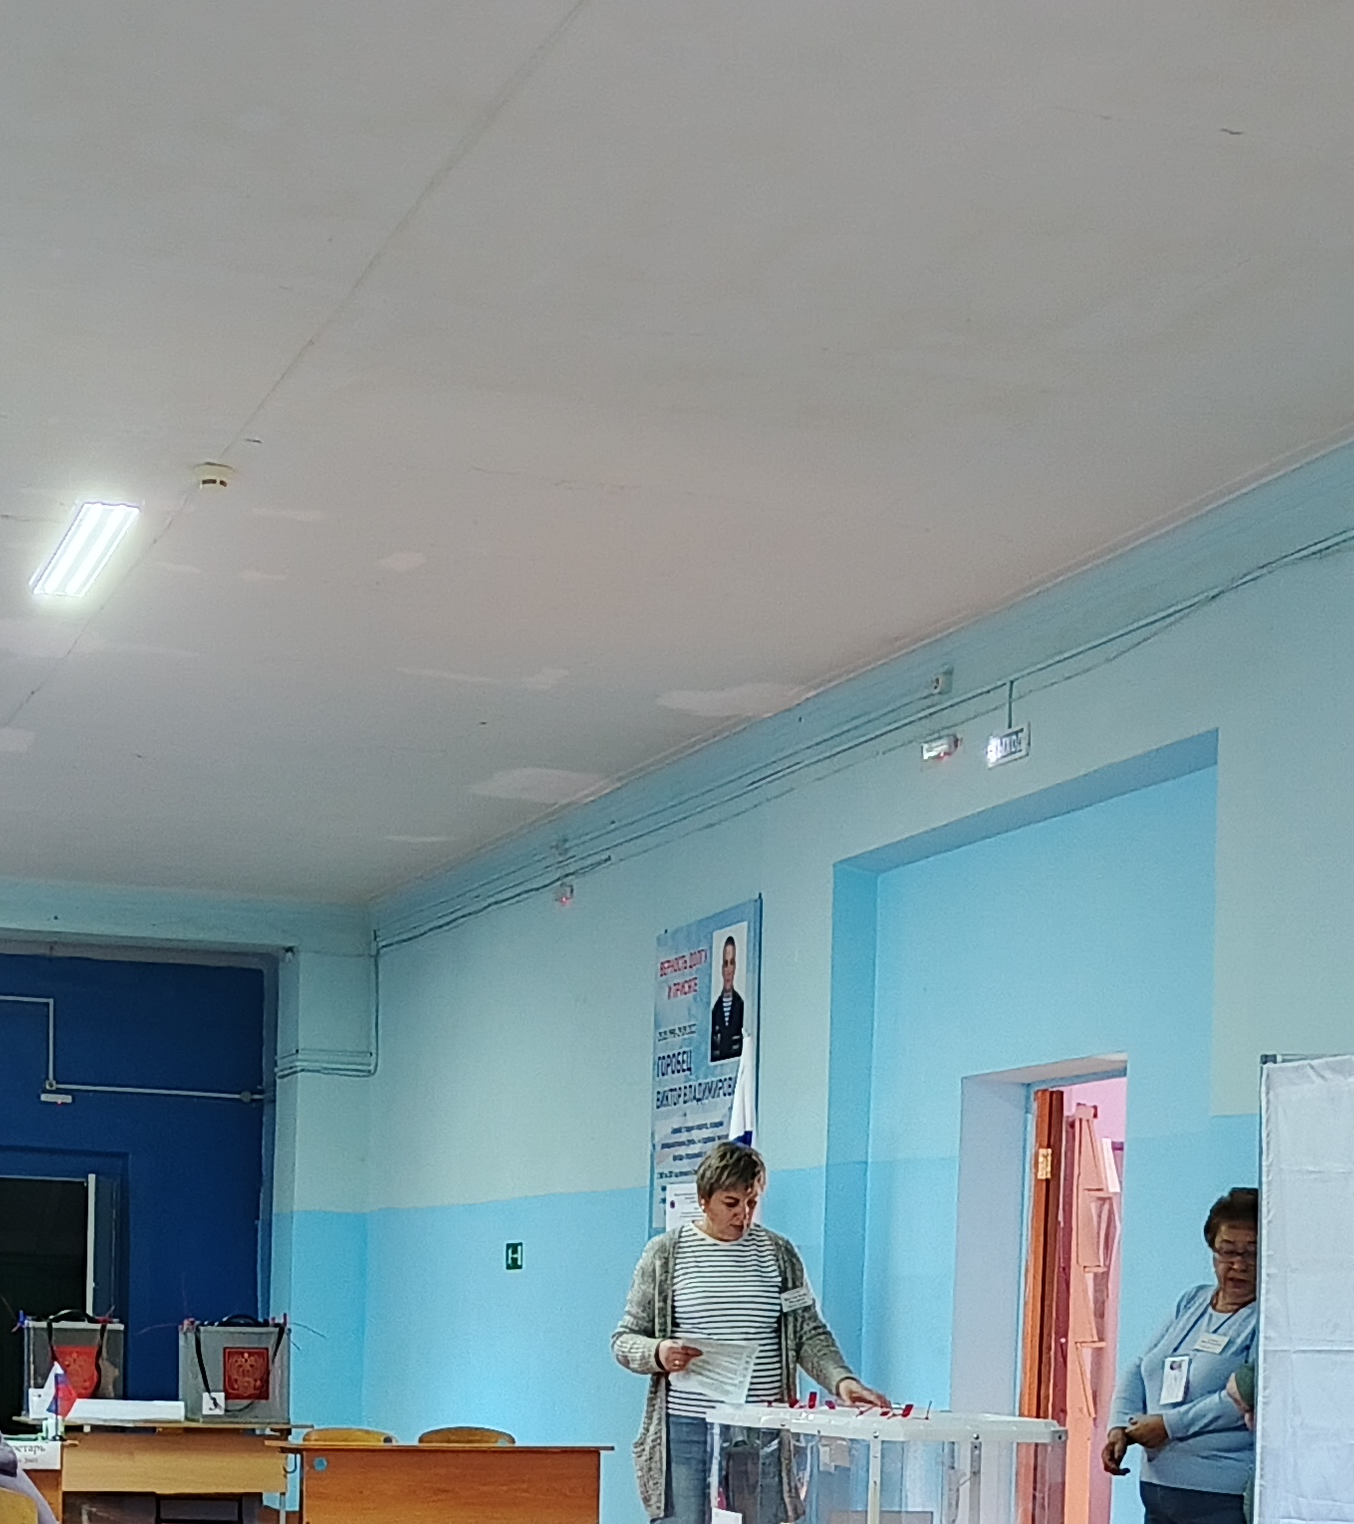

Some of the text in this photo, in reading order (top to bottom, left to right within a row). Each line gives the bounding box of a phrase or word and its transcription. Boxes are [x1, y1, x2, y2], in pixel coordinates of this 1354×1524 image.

[656, 1048, 692, 1078] ГОРОБЕЦ
[655, 1076, 736, 1110] ВИКТОР ВЛАДИМИРОВ
